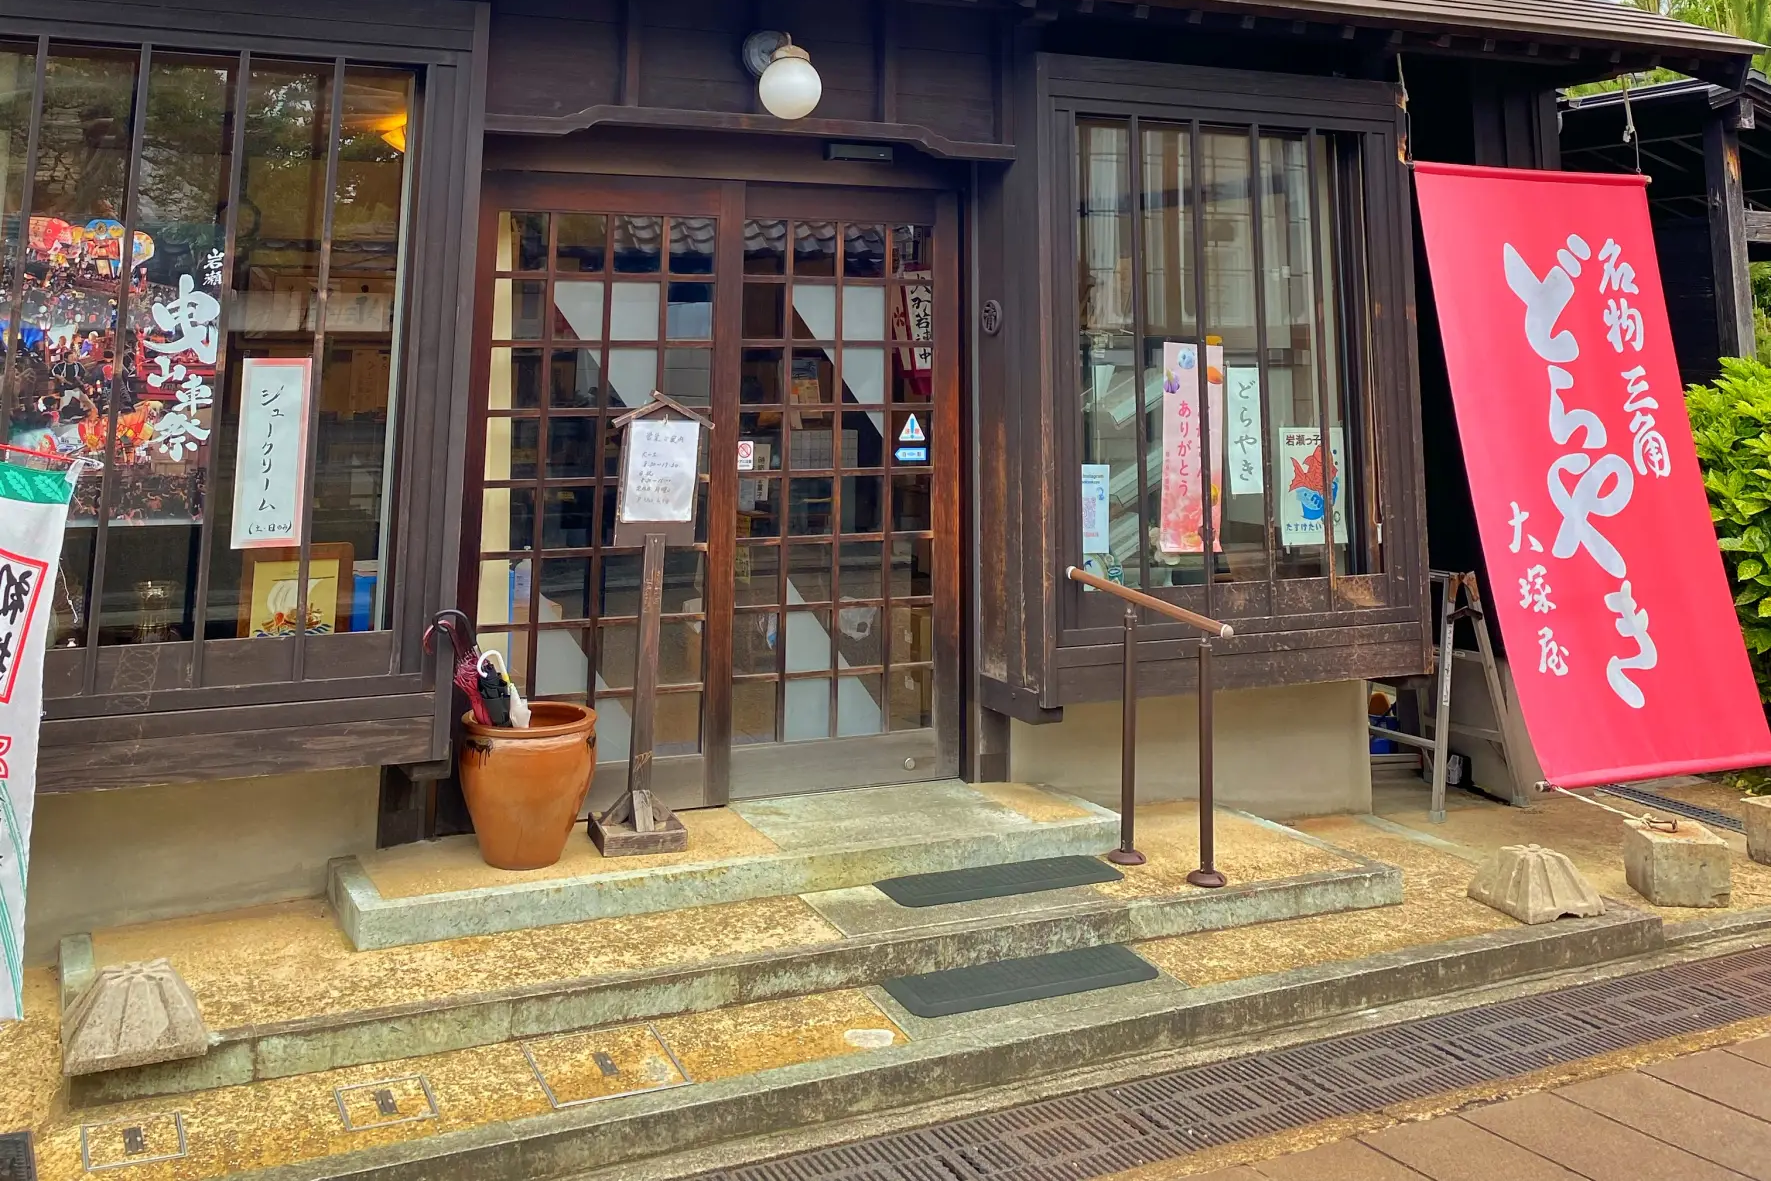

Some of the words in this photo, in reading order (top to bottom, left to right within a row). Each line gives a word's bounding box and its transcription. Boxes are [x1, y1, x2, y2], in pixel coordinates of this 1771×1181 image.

[202, 248, 225, 286] 岩瀬
[1598, 238, 1672, 479] 名物三角
[258, 385, 285, 511] シュークリーム
[1177, 400, 1193, 497] ありがとう
[1234, 380, 1258, 481] どらやき
[1285, 434, 1322, 447] 岩瀬っ子
[1503, 233, 1659, 709] どらやき
[1508, 502, 1570, 678] 大塚屋
